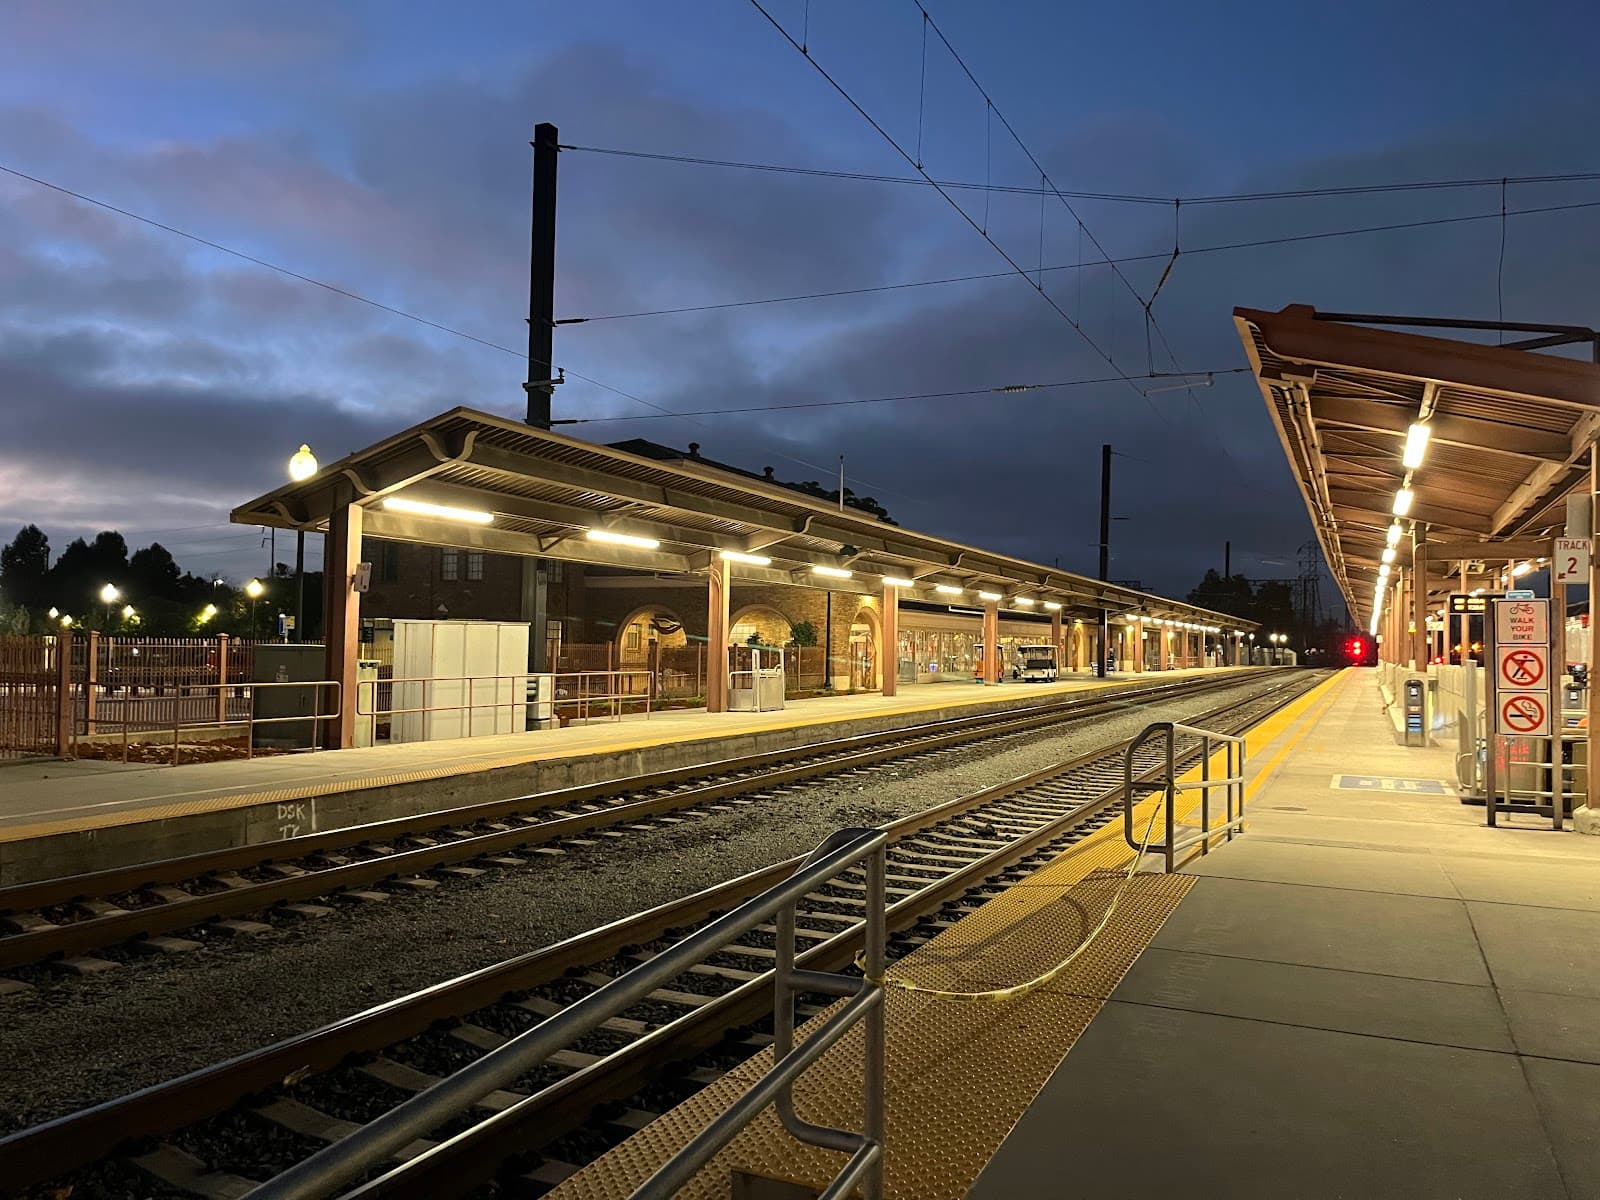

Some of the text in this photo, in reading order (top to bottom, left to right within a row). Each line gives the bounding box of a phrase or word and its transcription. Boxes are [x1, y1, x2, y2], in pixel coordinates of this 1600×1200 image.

[1557, 540, 1588, 549] TRACK
[1567, 556, 1577, 574] 2
[277, 803, 306, 820] DSK
